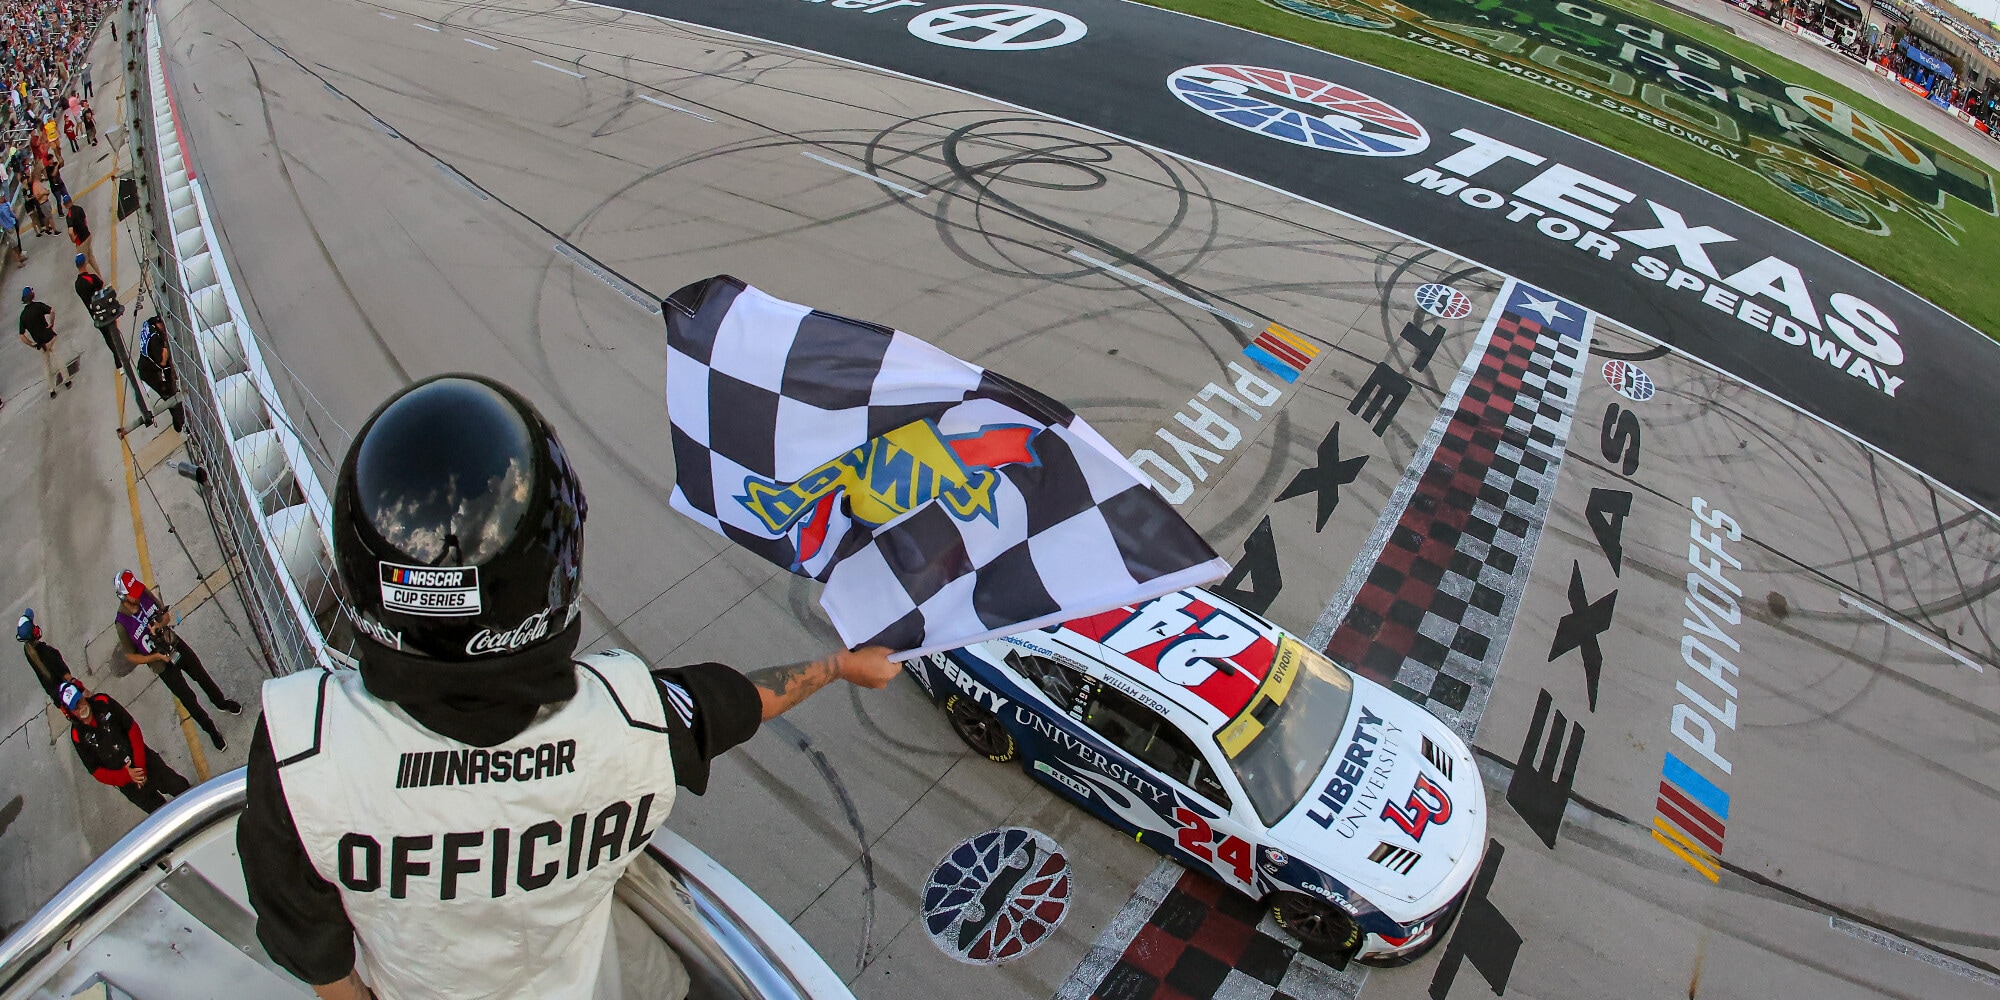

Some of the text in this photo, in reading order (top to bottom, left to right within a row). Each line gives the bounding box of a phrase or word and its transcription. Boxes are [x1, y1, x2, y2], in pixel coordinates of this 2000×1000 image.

[1407, 31, 1740, 160] TEXAS MOTOR SPEEDWAY
[1422, 19, 1740, 142] 400
[1403, 168, 1905, 398] MOTOR SPEEDWAY
[1434, 129, 1905, 367] TEXAS
[1128, 360, 1283, 505] PLAYO
[1210, 322, 1446, 616] TEXA
[394, 590, 466, 607] CUP SERIES
[408, 571, 463, 587] NASCAR
[1665, 497, 1742, 775] PLAYOFFS
[1103, 673, 1171, 716] WILLIAM BYRON
[1272, 648, 1292, 684] BYRON
[1428, 403, 1640, 1000] TEXAS
[446, 739, 577, 787] NASCAR
[926, 651, 1009, 714] BERTY
[1015, 706, 1168, 803] UNIVERSITY
[1051, 770, 1088, 795] RELAY
[1306, 705, 1383, 830] LIBERTY
[1336, 721, 1403, 839] UNIVERSITY
[337, 793, 656, 900] OFFICIAL
[1176, 806, 1254, 886] 24
[1379, 770, 1453, 844] LU
[1301, 881, 1360, 915] GOODYEAR
